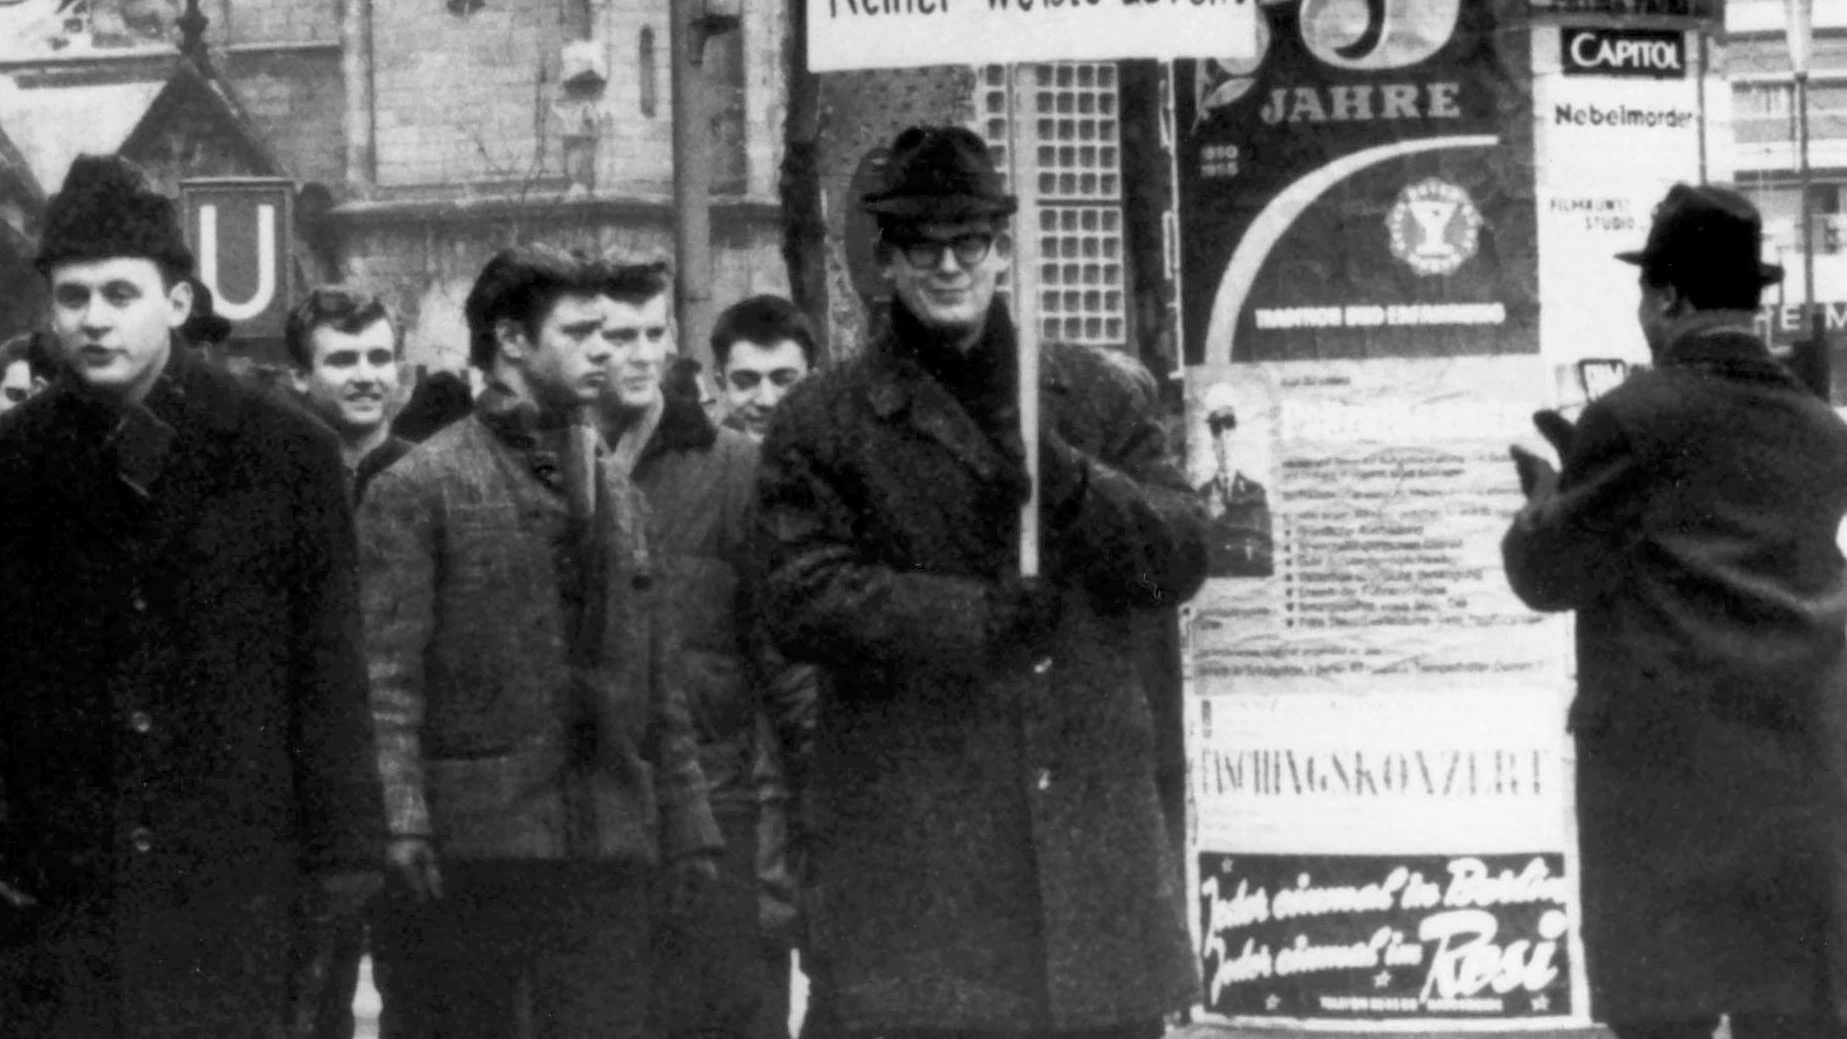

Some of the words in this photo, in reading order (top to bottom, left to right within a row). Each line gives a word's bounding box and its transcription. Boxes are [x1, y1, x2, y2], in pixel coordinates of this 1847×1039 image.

[1571, 32, 1681, 70] CAPITOL
[1261, 82, 1461, 125] JAHRE
[199, 203, 275, 320] U
[1443, 857, 1567, 908] Berlin
[1418, 908, 1567, 1006] Resi
